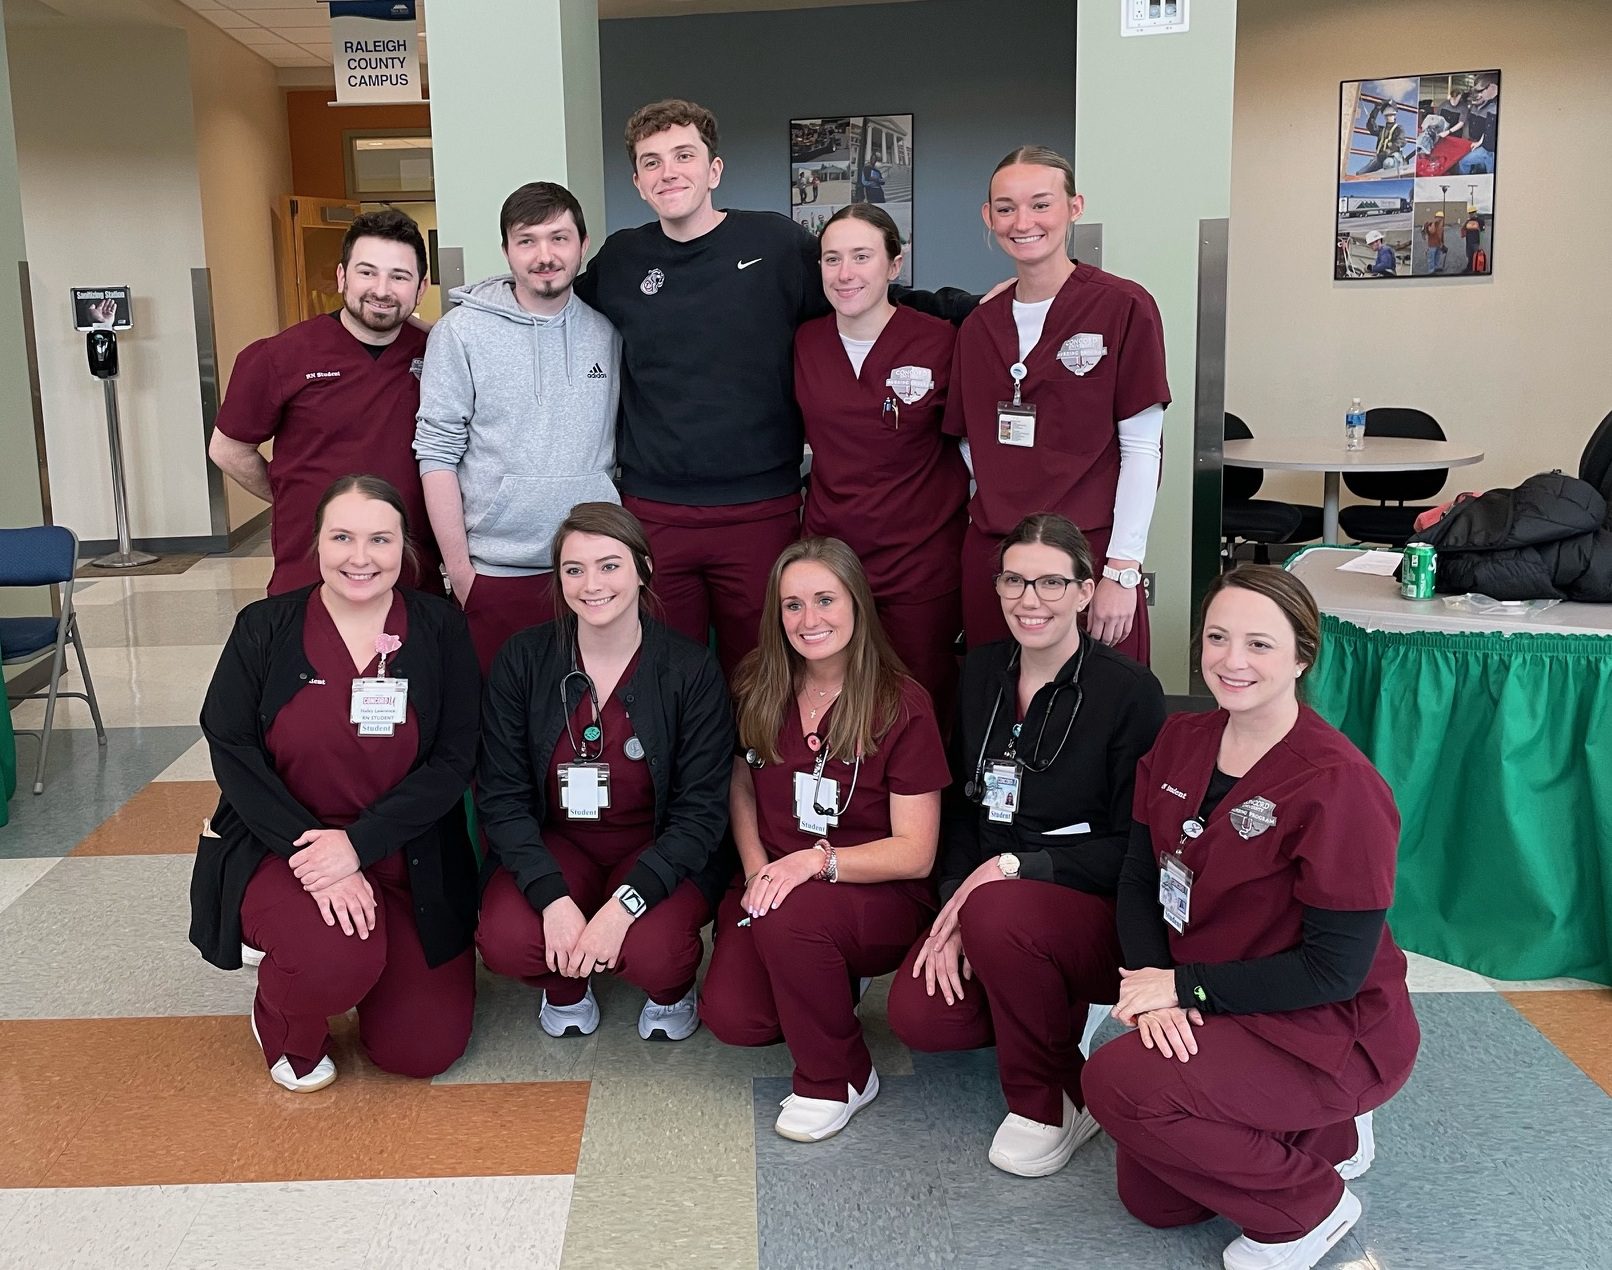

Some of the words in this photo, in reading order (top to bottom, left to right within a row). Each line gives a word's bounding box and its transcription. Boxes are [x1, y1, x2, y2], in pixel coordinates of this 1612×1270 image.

[344, 40, 407, 53] RALEIGH
[347, 57, 406, 70] COUNTY
[348, 74, 409, 87] CAMPUS
[104, 290, 125, 299] Station
[991, 810, 1012, 820] Student
[801, 821, 826, 833] Student
